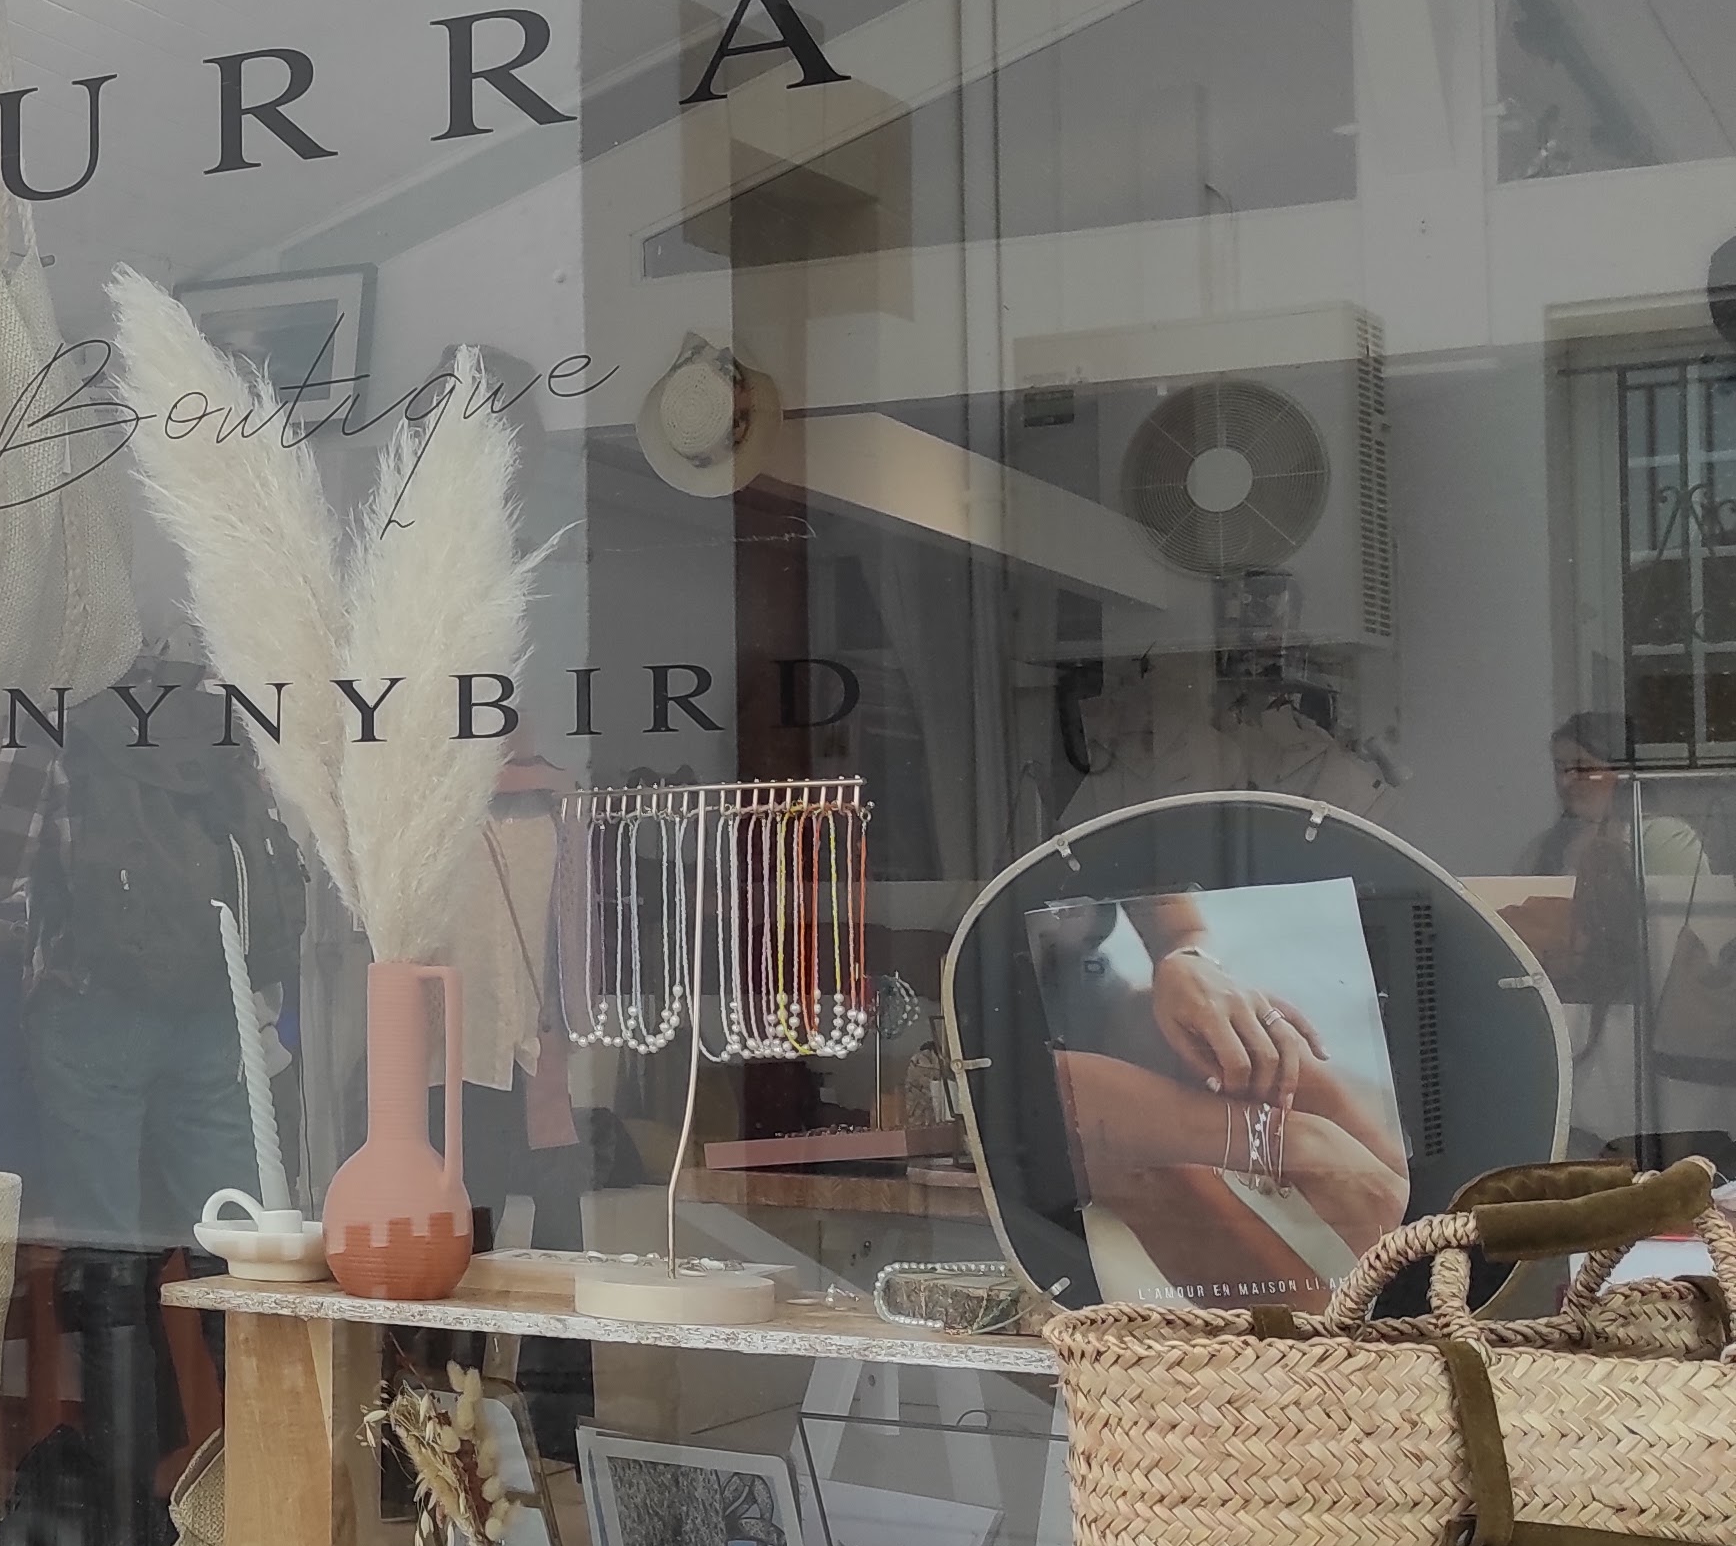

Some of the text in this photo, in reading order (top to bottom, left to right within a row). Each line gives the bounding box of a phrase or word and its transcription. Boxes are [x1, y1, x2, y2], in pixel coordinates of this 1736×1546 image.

[2, 658, 861, 749] NYNYBIRD
[1138, 1283, 1206, 1300] L'AMOUR
[1213, 1283, 1231, 1297] EN
[1238, 1278, 1298, 1296] MAISON
